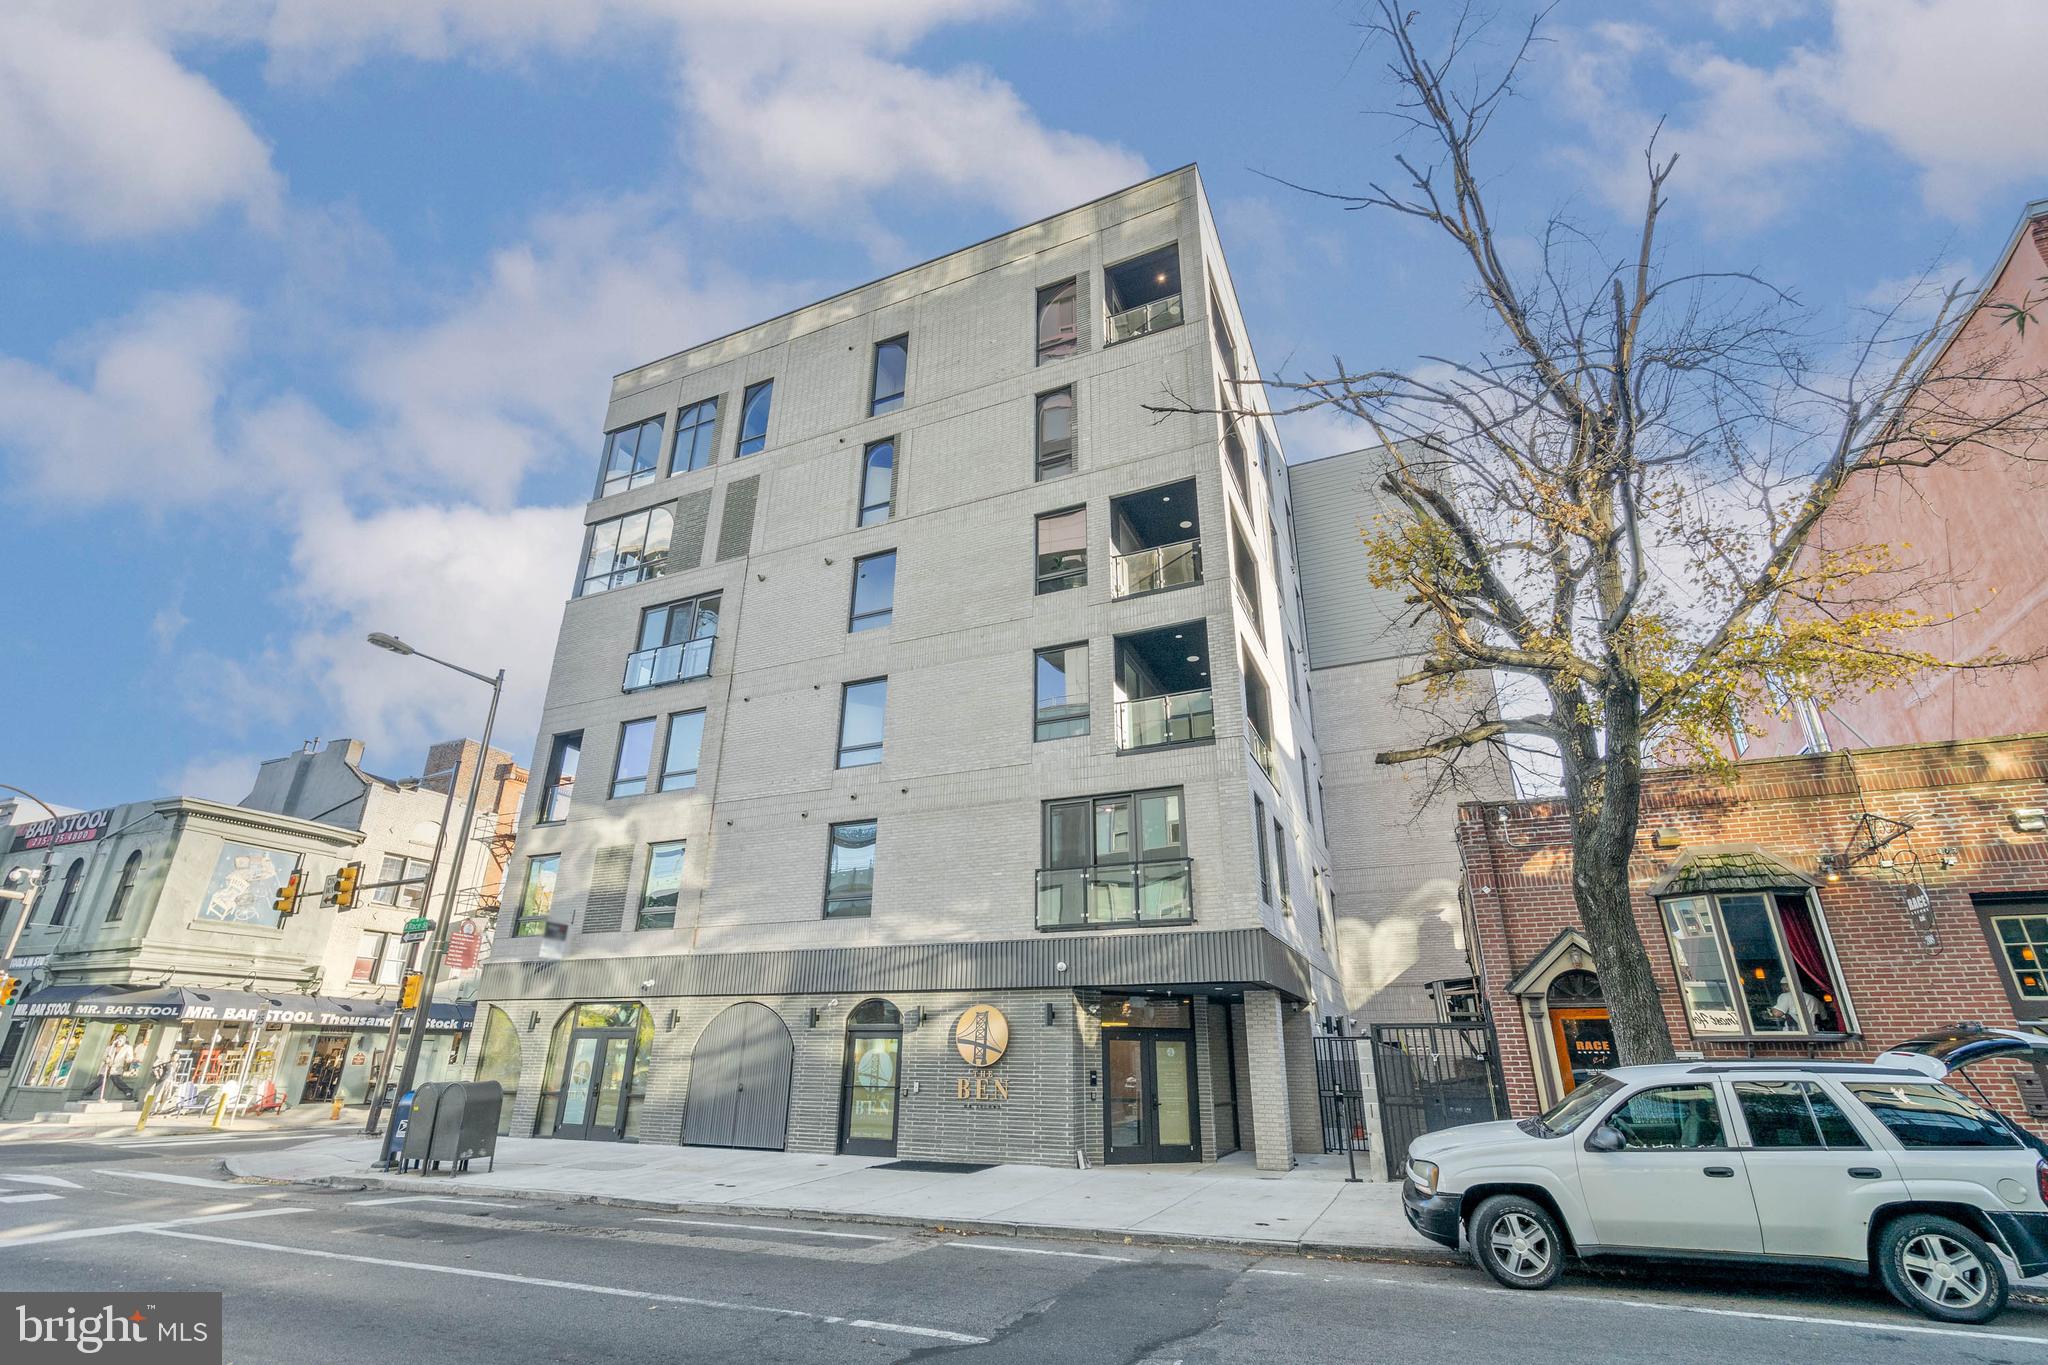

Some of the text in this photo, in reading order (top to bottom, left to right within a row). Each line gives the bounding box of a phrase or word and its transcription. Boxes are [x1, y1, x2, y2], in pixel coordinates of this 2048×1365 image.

[25, 819, 57, 839] BAR
[59, 810, 108, 834] STOOL
[1907, 895, 1928, 910] RACE
[14, 1003, 71, 1016] MR. BAR STOOL
[75, 1005, 179, 1016] MR. BAR STOOL
[184, 1006, 218, 1019] MR.
[222, 1007, 258, 1022] BAR
[266, 1009, 314, 1023] STOOL
[320, 1013, 393, 1027] Thousand
[255, 1015, 265, 1025] 25
[1575, 1040, 1610, 1050] RACE
[972, 1070, 994, 1078] THE
[957, 1077, 1009, 1100] BEN
